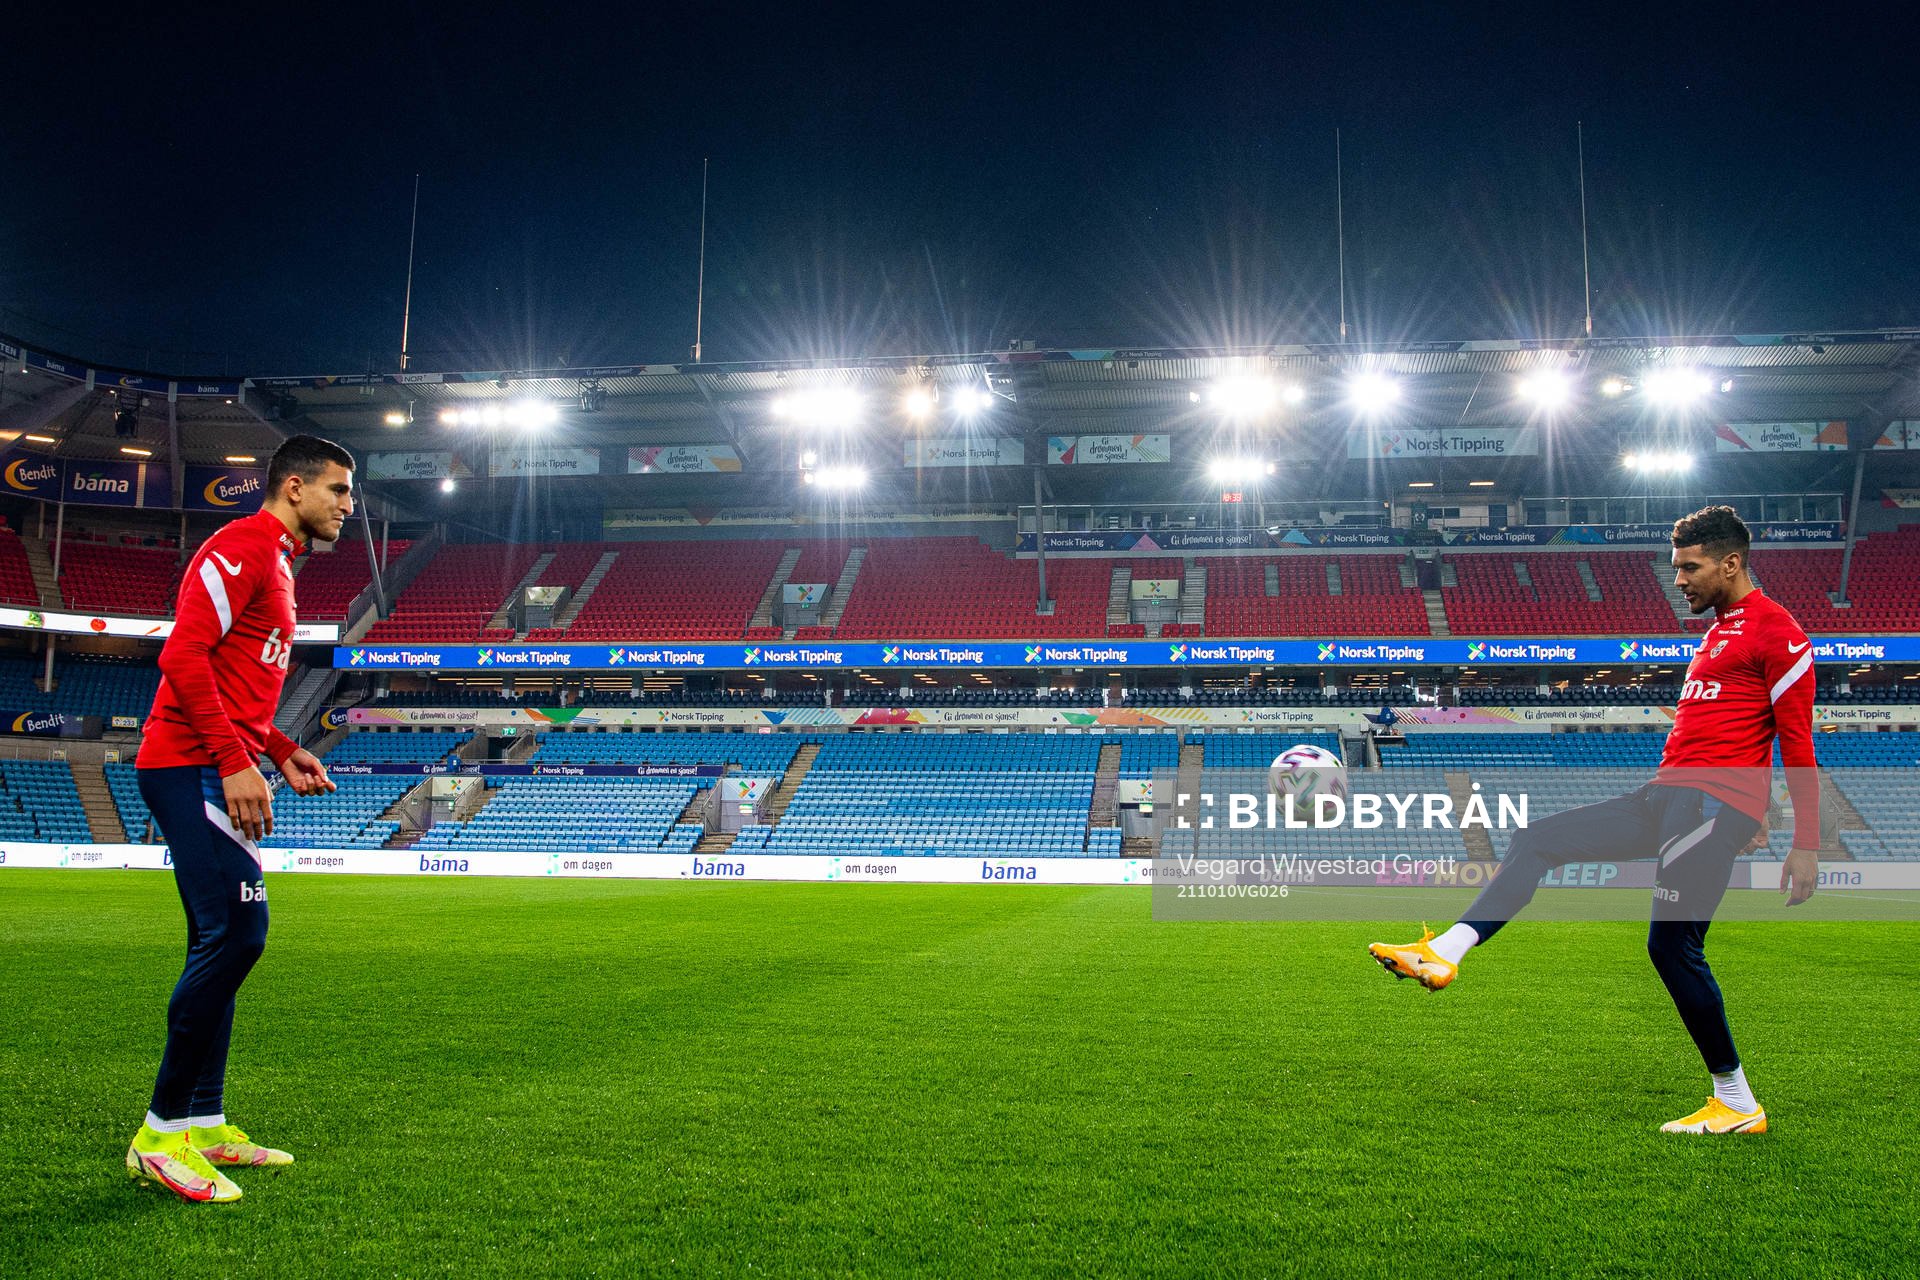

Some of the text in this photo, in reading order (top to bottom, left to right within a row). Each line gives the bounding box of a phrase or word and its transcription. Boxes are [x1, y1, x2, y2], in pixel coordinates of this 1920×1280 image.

[1407, 437, 1504, 452] Norsk Tipping
[549, 458, 577, 470] Tipping
[19, 465, 57, 481] Bendit
[73, 471, 129, 493] bama
[219, 477, 260, 498] Bendit
[1171, 535, 1180, 544] Gi
[1225, 533, 1252, 546] sjanse!
[1333, 534, 1389, 544] Norsk Tipping
[1479, 532, 1536, 542] Norsk Tipping
[1775, 528, 1832, 538] Norsk Tipping
[1050, 538, 1104, 547] Norsk Tipping
[260, 627, 291, 670] ba
[903, 648, 984, 663] Norsk Tipping
[1046, 648, 1128, 663] Norsk Tipping
[1191, 646, 1275, 661] Norsk Tipping
[1339, 645, 1424, 660] Norsk Tipping
[1490, 644, 1576, 660] Norsk Tipping
[1642, 644, 1680, 657] Norsk
[1813, 642, 1884, 658] rsk Tipping
[368, 652, 441, 666] Norsk Tipping
[496, 651, 571, 666] Norsk Tipping
[628, 651, 705, 665] Norsk Tipping
[764, 649, 843, 664] Norsk Tipping
[331, 713, 347, 724] Ben
[671, 712, 724, 722] Norsk Tipping
[944, 711, 953, 721] Gi
[995, 711, 1019, 723] sjanse!
[1256, 712, 1313, 722] Norsk Tipping
[1525, 710, 1534, 720] Gi
[1580, 710, 1605, 722] sjanse!
[1831, 709, 1891, 720] Norsk Tipping
[27, 713, 65, 732] Bendit
[333, 765, 372, 775] Norsk Tipping
[561, 767, 584, 775] Tipping
[298, 855, 344, 868] om dagen
[419, 854, 469, 872] bama
[563, 860, 579, 870] om
[582, 860, 613, 872] dagen
[693, 857, 745, 876] bama
[845, 865, 861, 874] om
[864, 863, 897, 876] dagen
[982, 861, 1037, 880] bama
[1142, 868, 1158, 877] om
[1434, 863, 1504, 885] MOV
[1538, 864, 1618, 886] LEEP
[1817, 872, 1862, 886] ama
